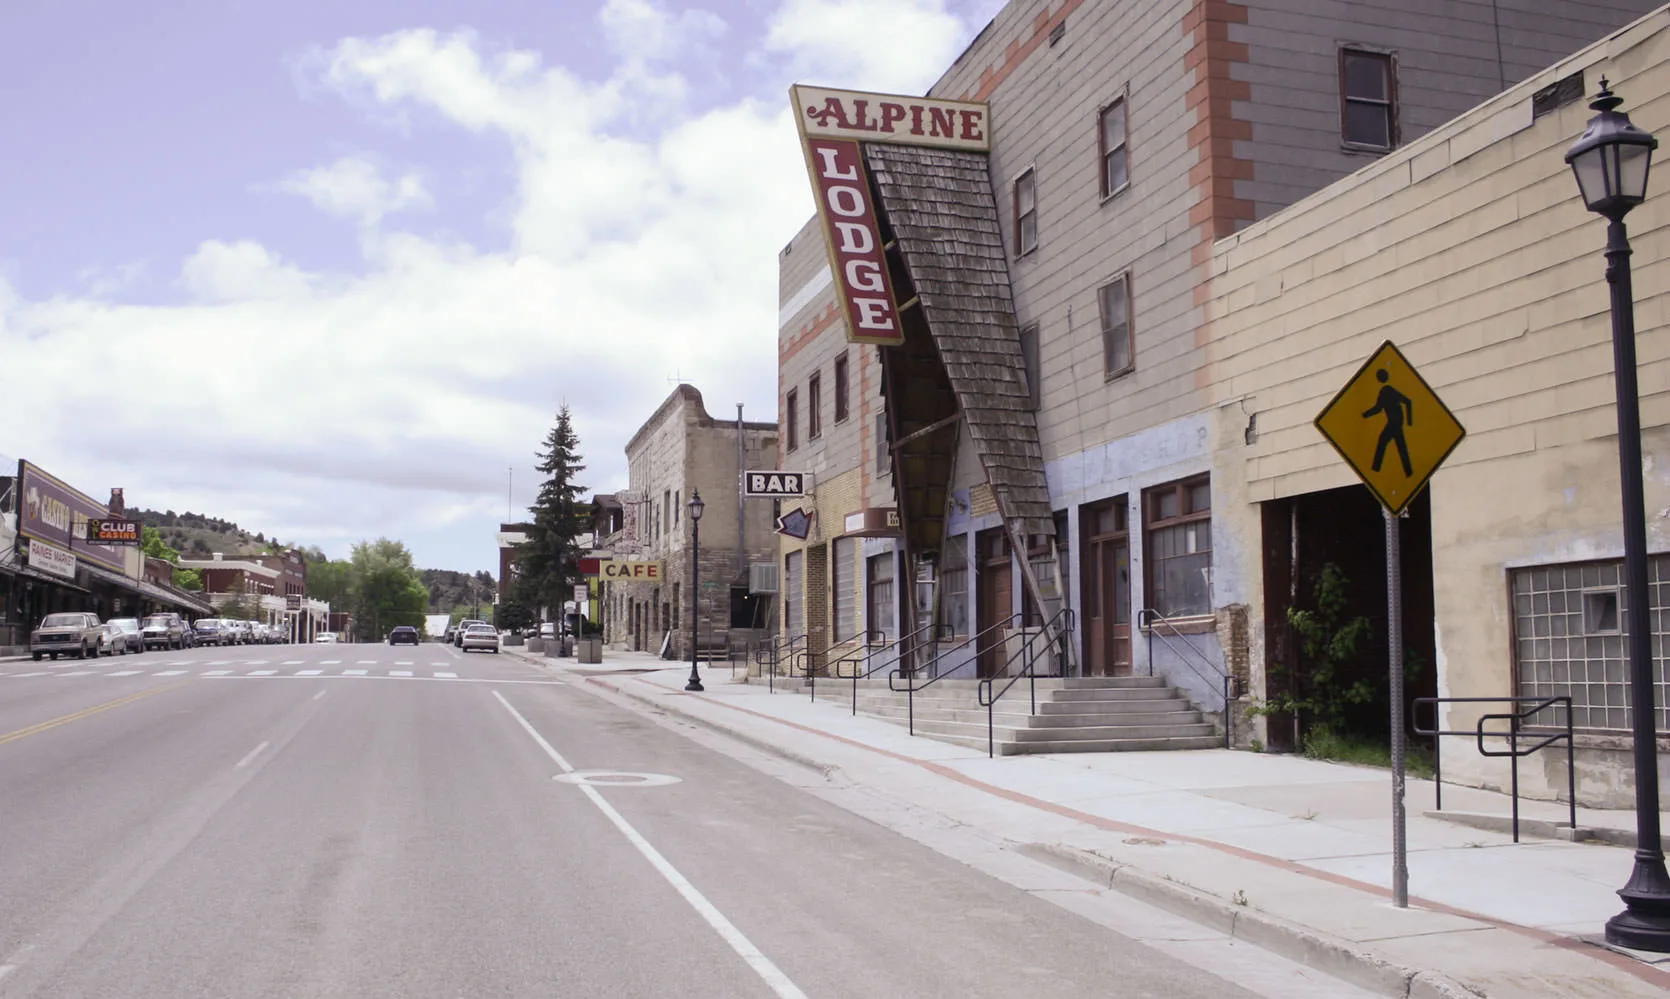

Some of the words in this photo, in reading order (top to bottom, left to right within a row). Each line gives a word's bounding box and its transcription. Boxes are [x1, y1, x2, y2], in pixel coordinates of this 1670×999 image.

[807, 97, 984, 141] ALPINE
[816, 147, 894, 331] LODGE
[752, 474, 799, 492] BAR
[41, 494, 70, 533] CASINO
[98, 531, 137, 540] CASINO
[101, 522, 136, 532] CLUB
[605, 564, 657, 577] CAFE
